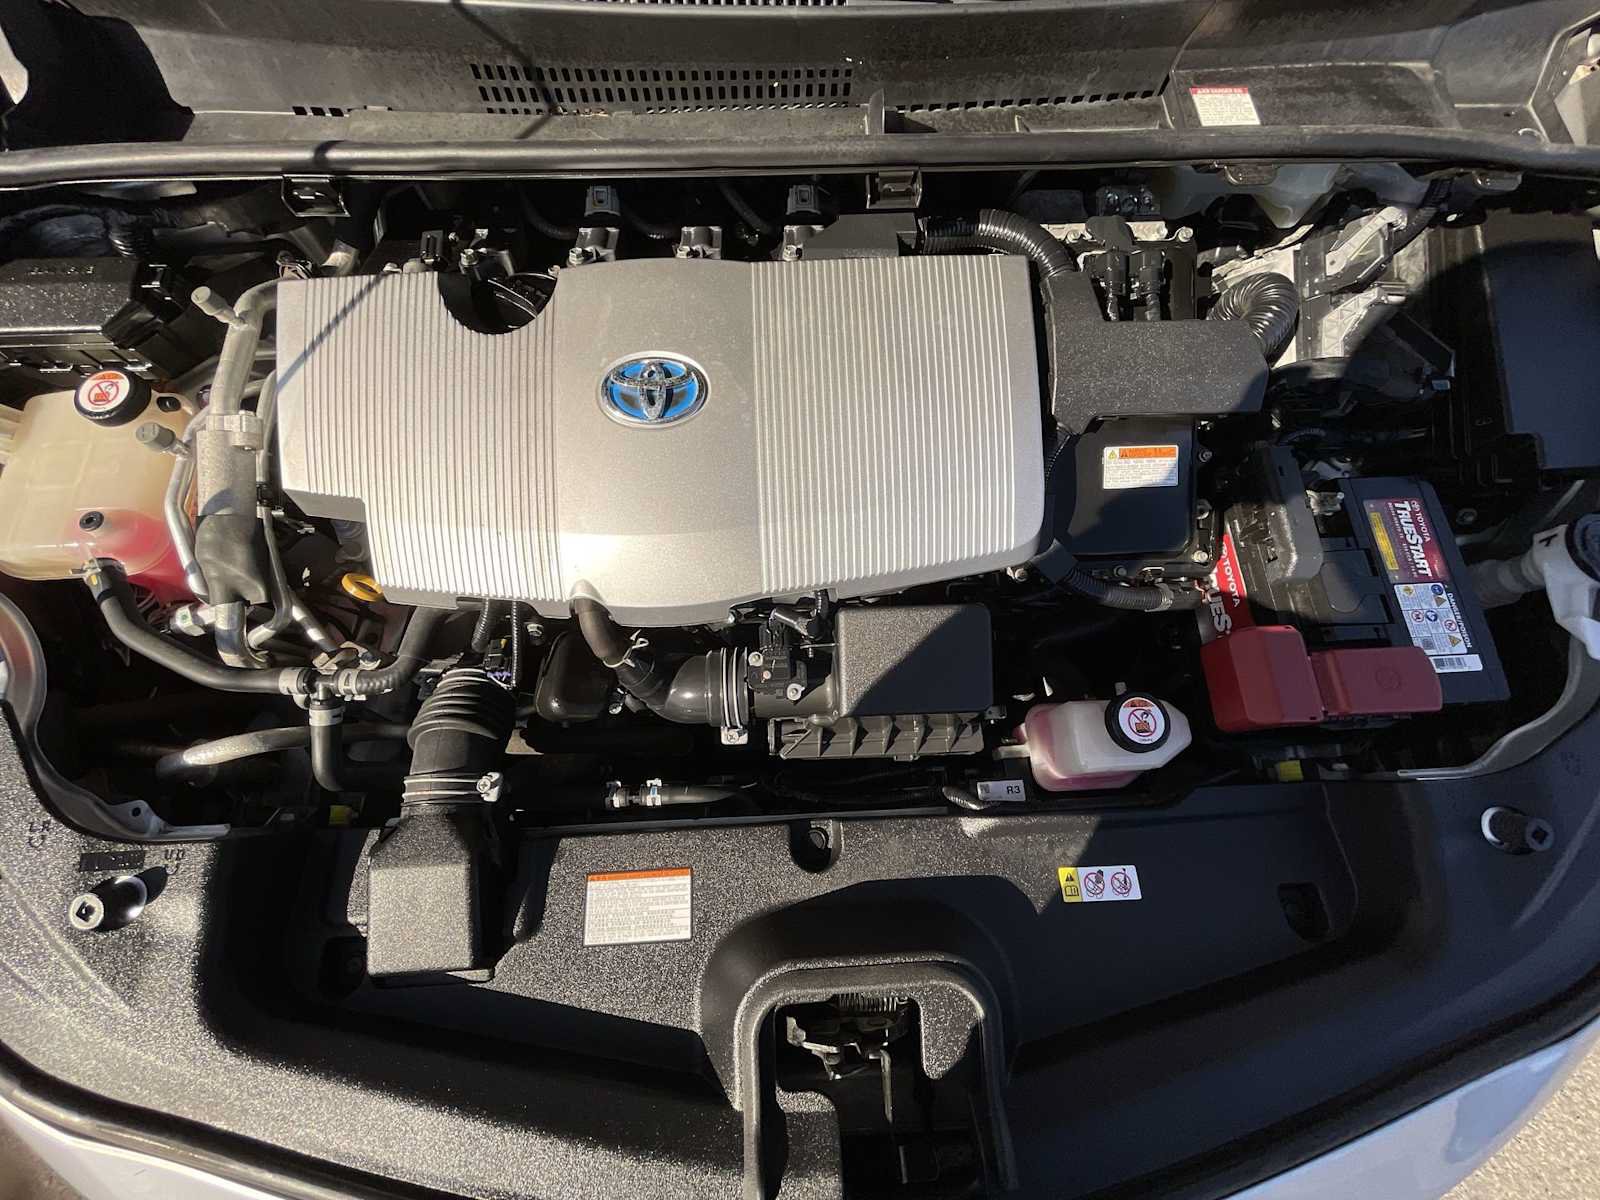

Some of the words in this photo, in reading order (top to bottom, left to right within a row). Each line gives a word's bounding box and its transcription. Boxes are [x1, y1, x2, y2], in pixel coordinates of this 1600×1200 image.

[1415, 512, 1431, 542] TOYOTA
[1223, 559, 1240, 608] TOYOTA
[1006, 785, 1021, 794] R3
